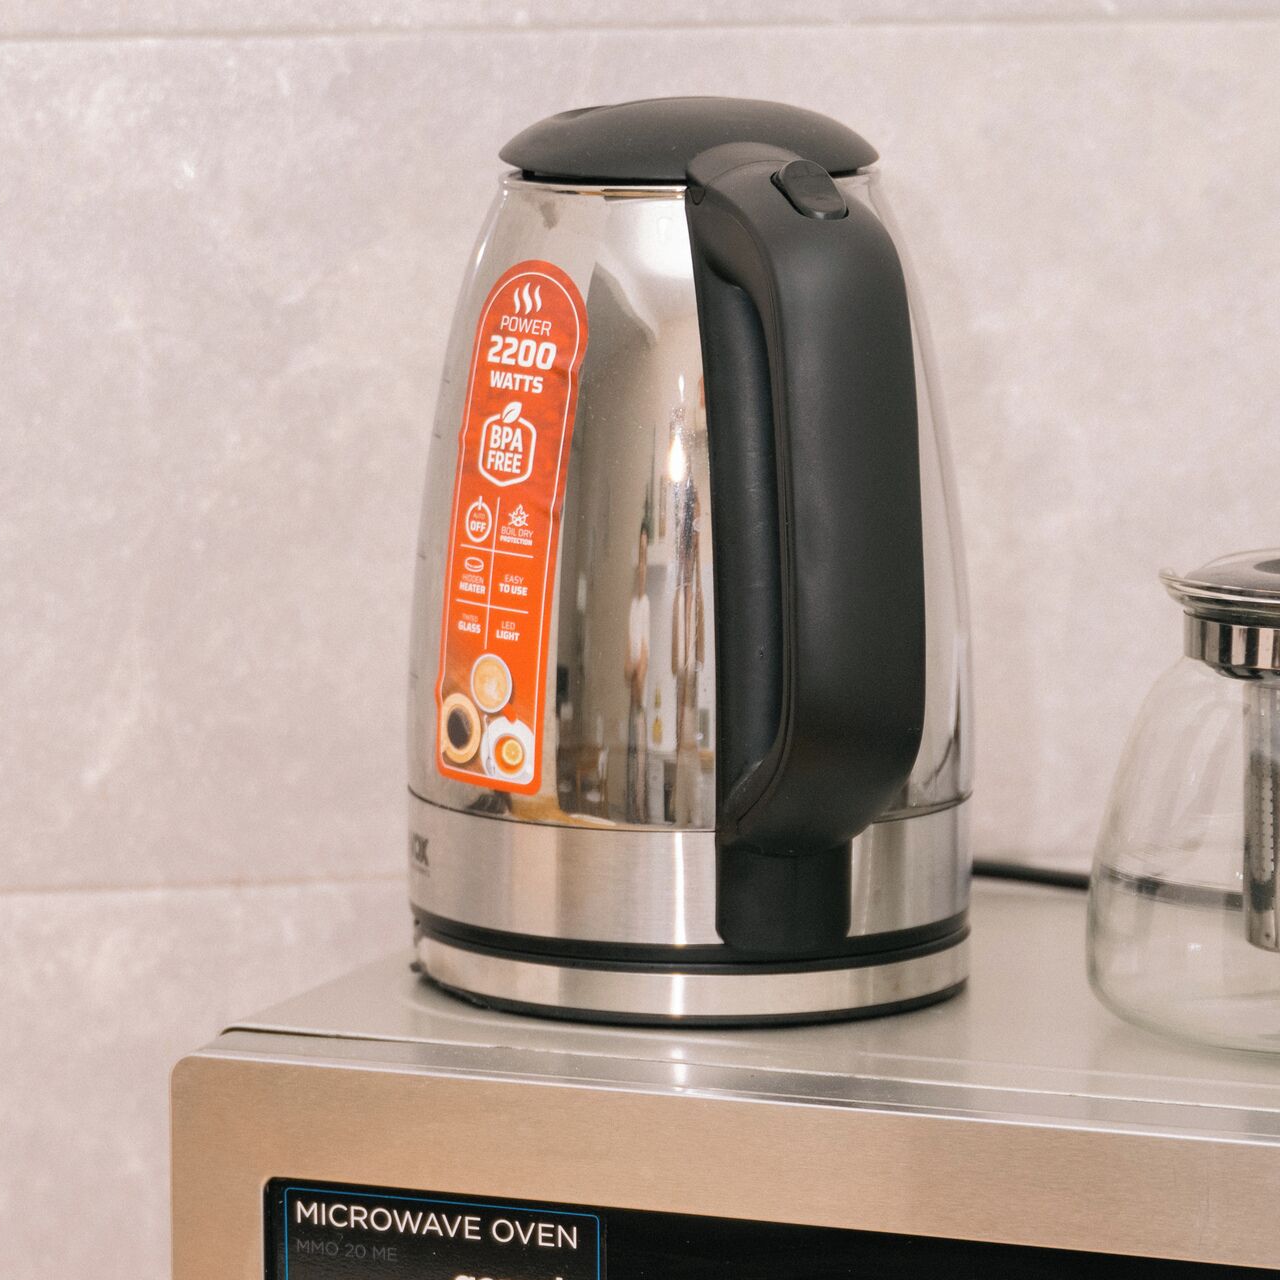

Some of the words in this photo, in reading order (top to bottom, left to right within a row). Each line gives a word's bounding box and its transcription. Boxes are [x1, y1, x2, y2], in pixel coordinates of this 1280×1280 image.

[500, 315, 552, 336] POWER
[487, 335, 557, 370] 2200
[490, 370, 544, 394] WATTS
[490, 425, 523, 452] BPA
[487, 451, 523, 474] FREE
[470, 520, 487, 532] OFF
[501, 526, 517, 537] BOIL
[518, 528, 534, 538] DRY
[500, 535, 533, 546] PROTECTION
[504, 574, 524, 584] EASY
[459, 582, 486, 594] HEATER
[499, 583, 510, 594] TO
[511, 585, 528, 596] USE
[458, 620, 481, 634] GLASS
[501, 621, 516, 631] LED
[496, 629, 520, 641] LIGHT
[296, 1201, 482, 1241] MICROWAVE
[492, 1219, 578, 1249] OVEN
[297, 1239, 339, 1256] MMO
[345, 1243, 366, 1259] 20
[372, 1246, 397, 1261] ME
